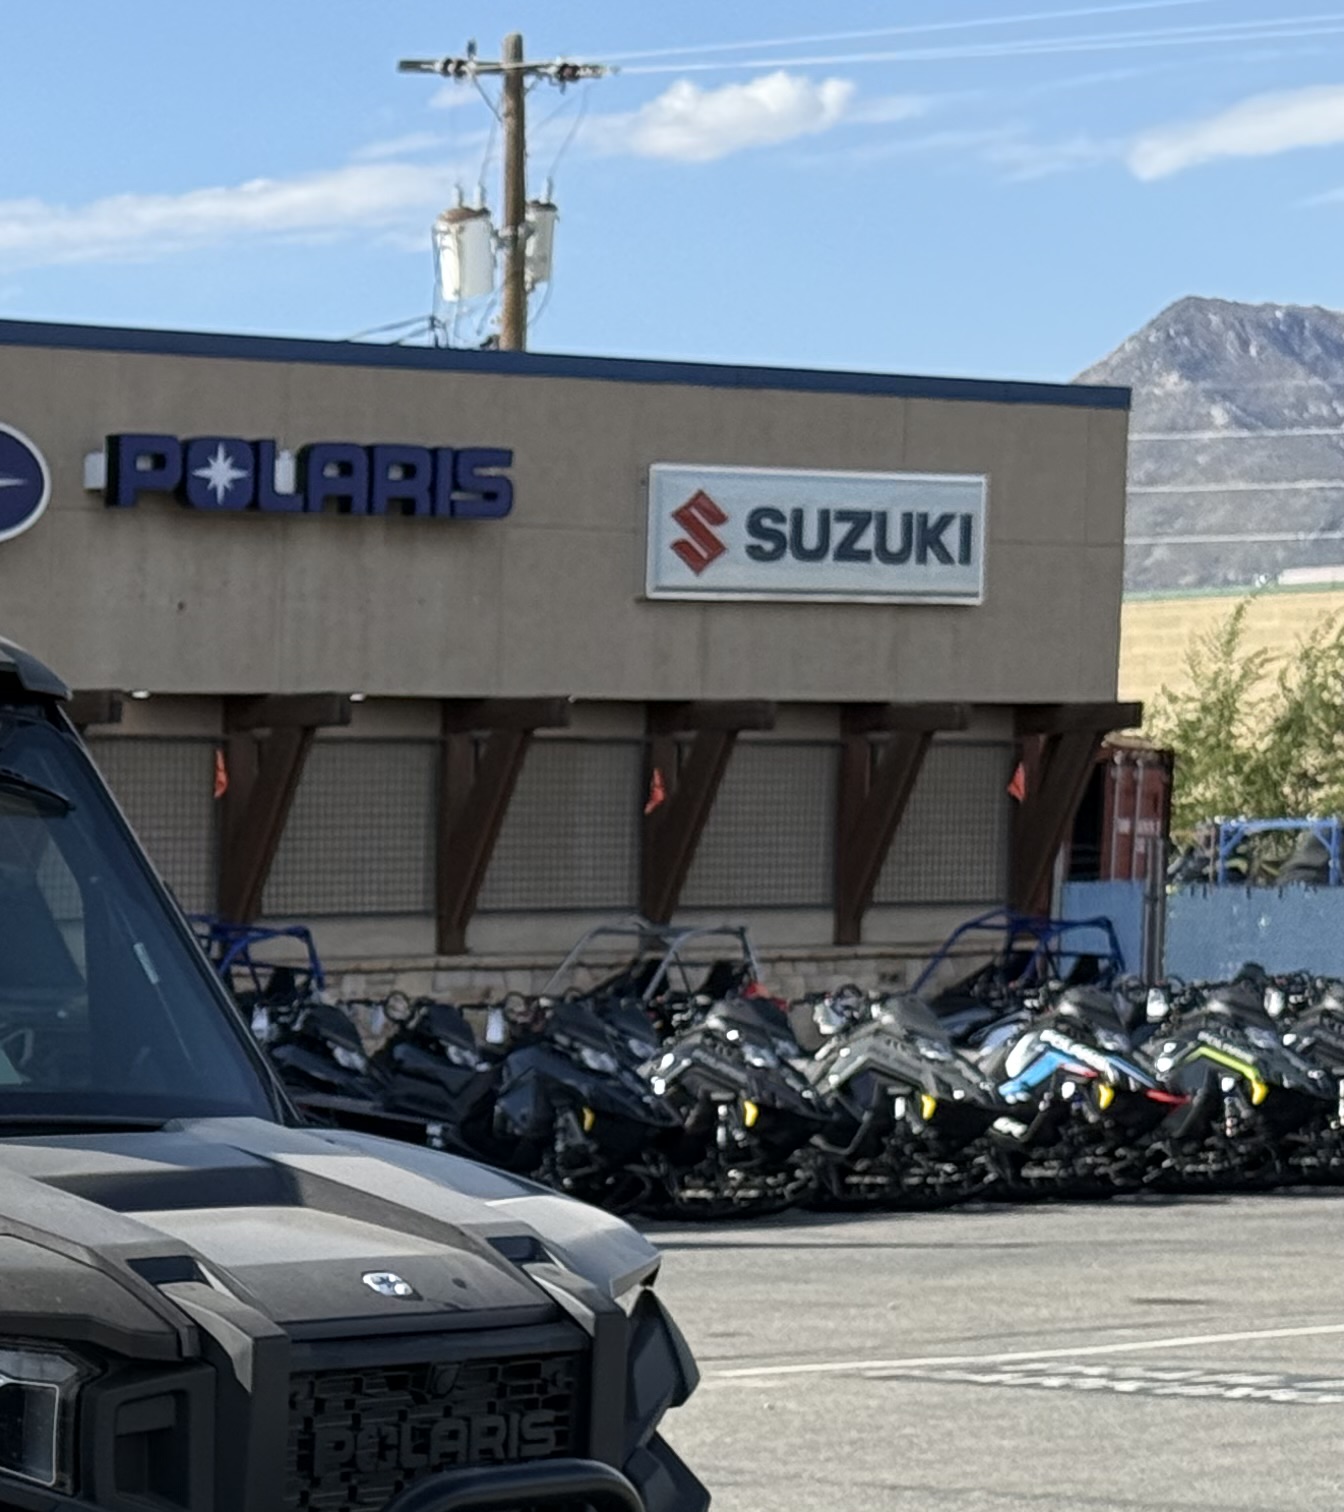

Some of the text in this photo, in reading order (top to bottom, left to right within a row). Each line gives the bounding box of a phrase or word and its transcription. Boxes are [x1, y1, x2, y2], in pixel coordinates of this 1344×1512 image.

[106, 433, 515, 520] POLARIS
[744, 506, 974, 566] SUZUKI
[312, 1408, 556, 1476] POLARIS
